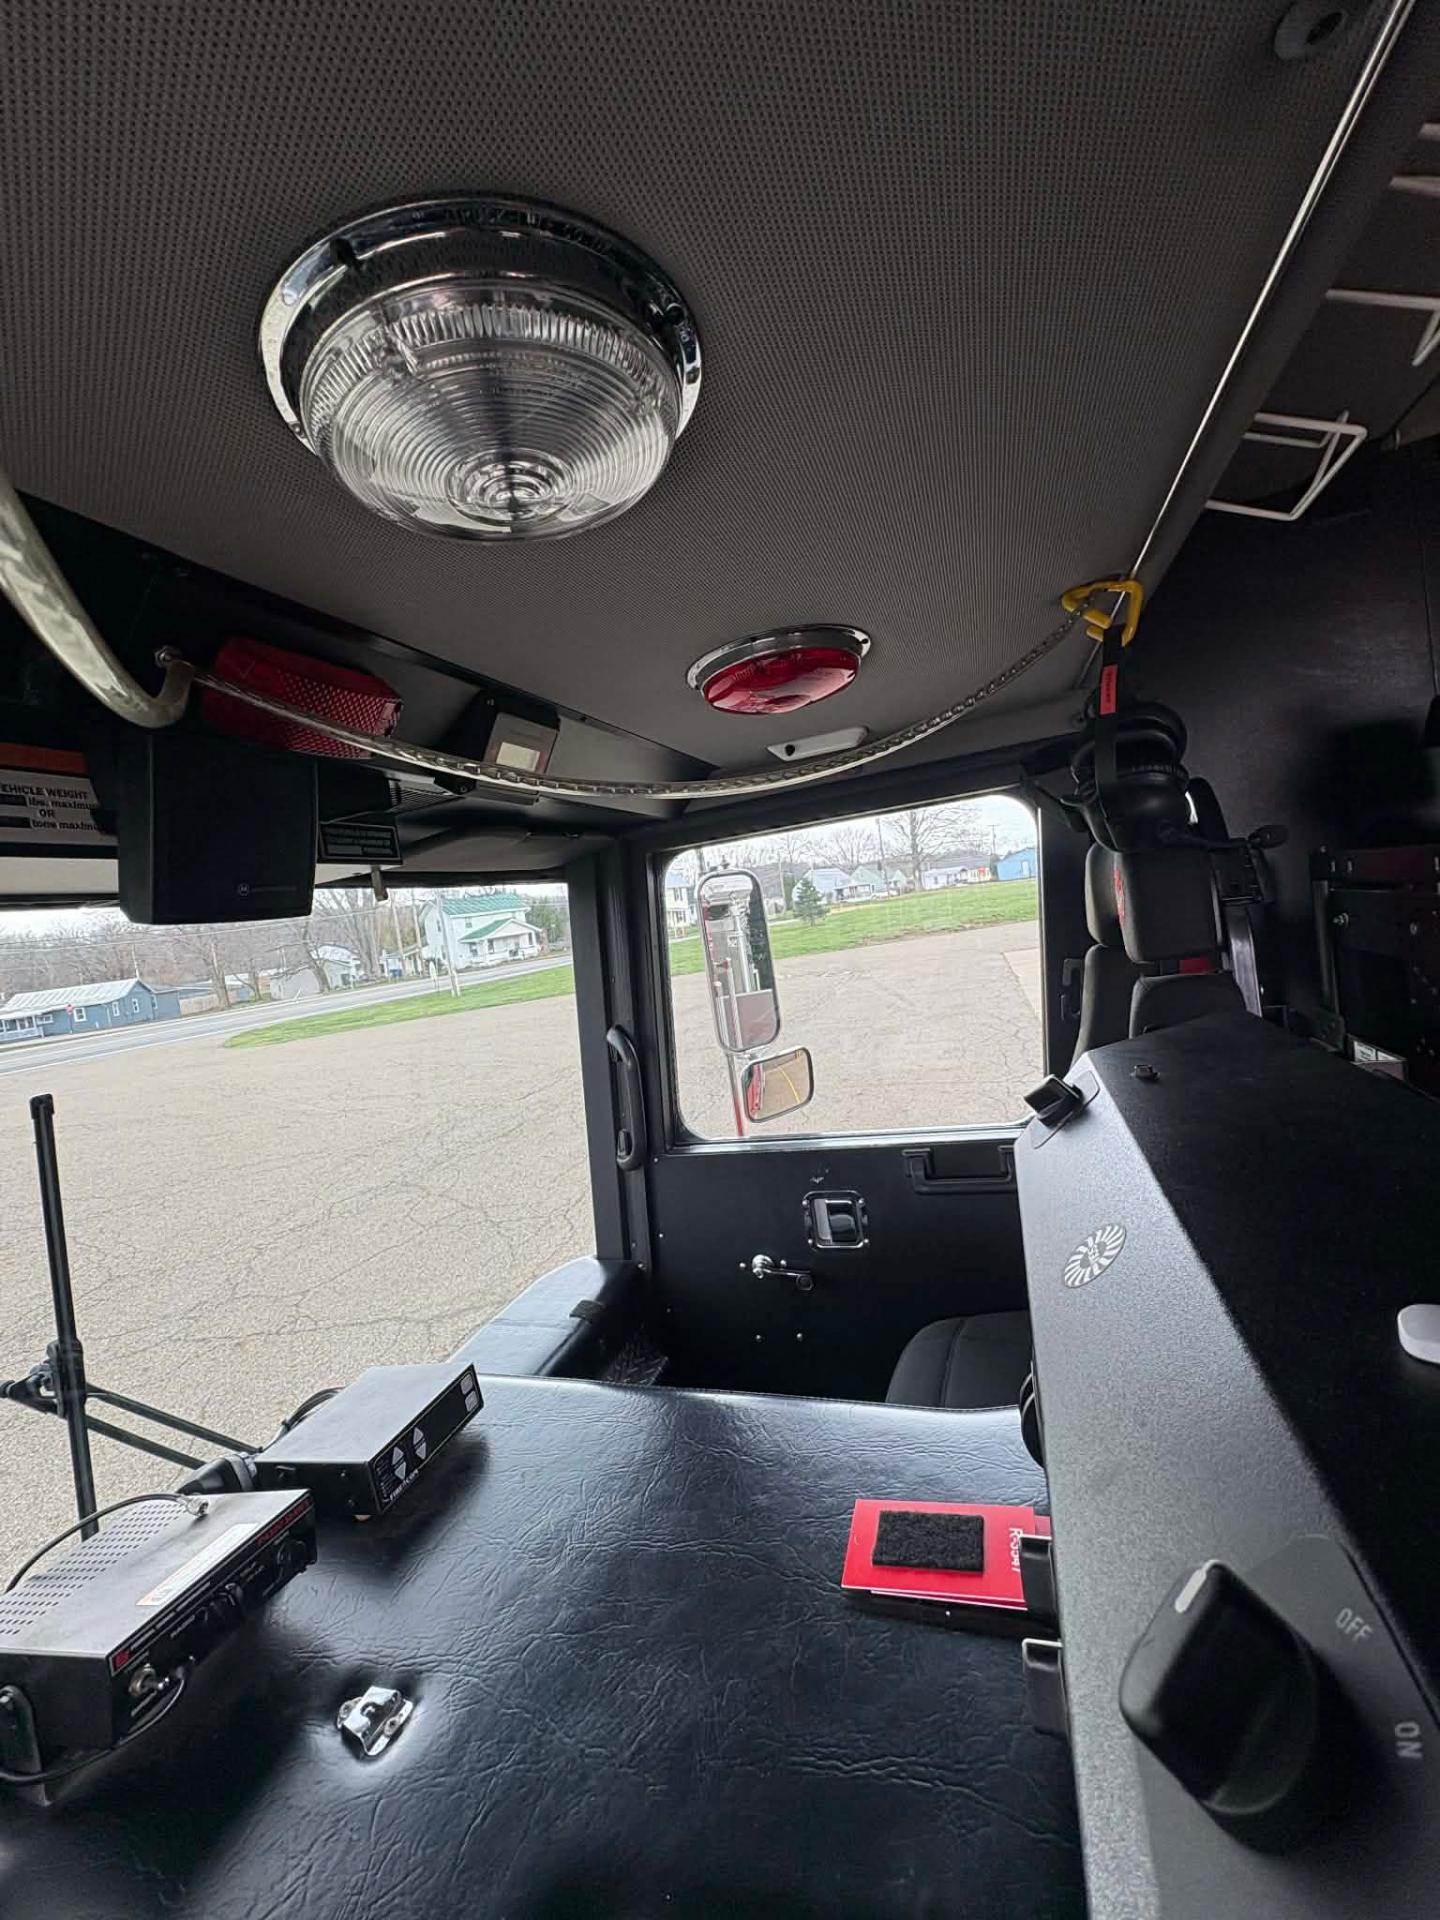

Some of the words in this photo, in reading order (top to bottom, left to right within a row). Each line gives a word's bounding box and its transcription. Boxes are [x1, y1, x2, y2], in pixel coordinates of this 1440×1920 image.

[1, 784, 45, 796] EHICLE
[48, 788, 88, 799] WEIGHT
[51, 800, 96, 810] maximu
[39, 808, 56, 818] OR
[59, 822, 97, 831] maxim
[1335, 1607, 1373, 1642] OFF
[1394, 1721, 1423, 1759] ON
